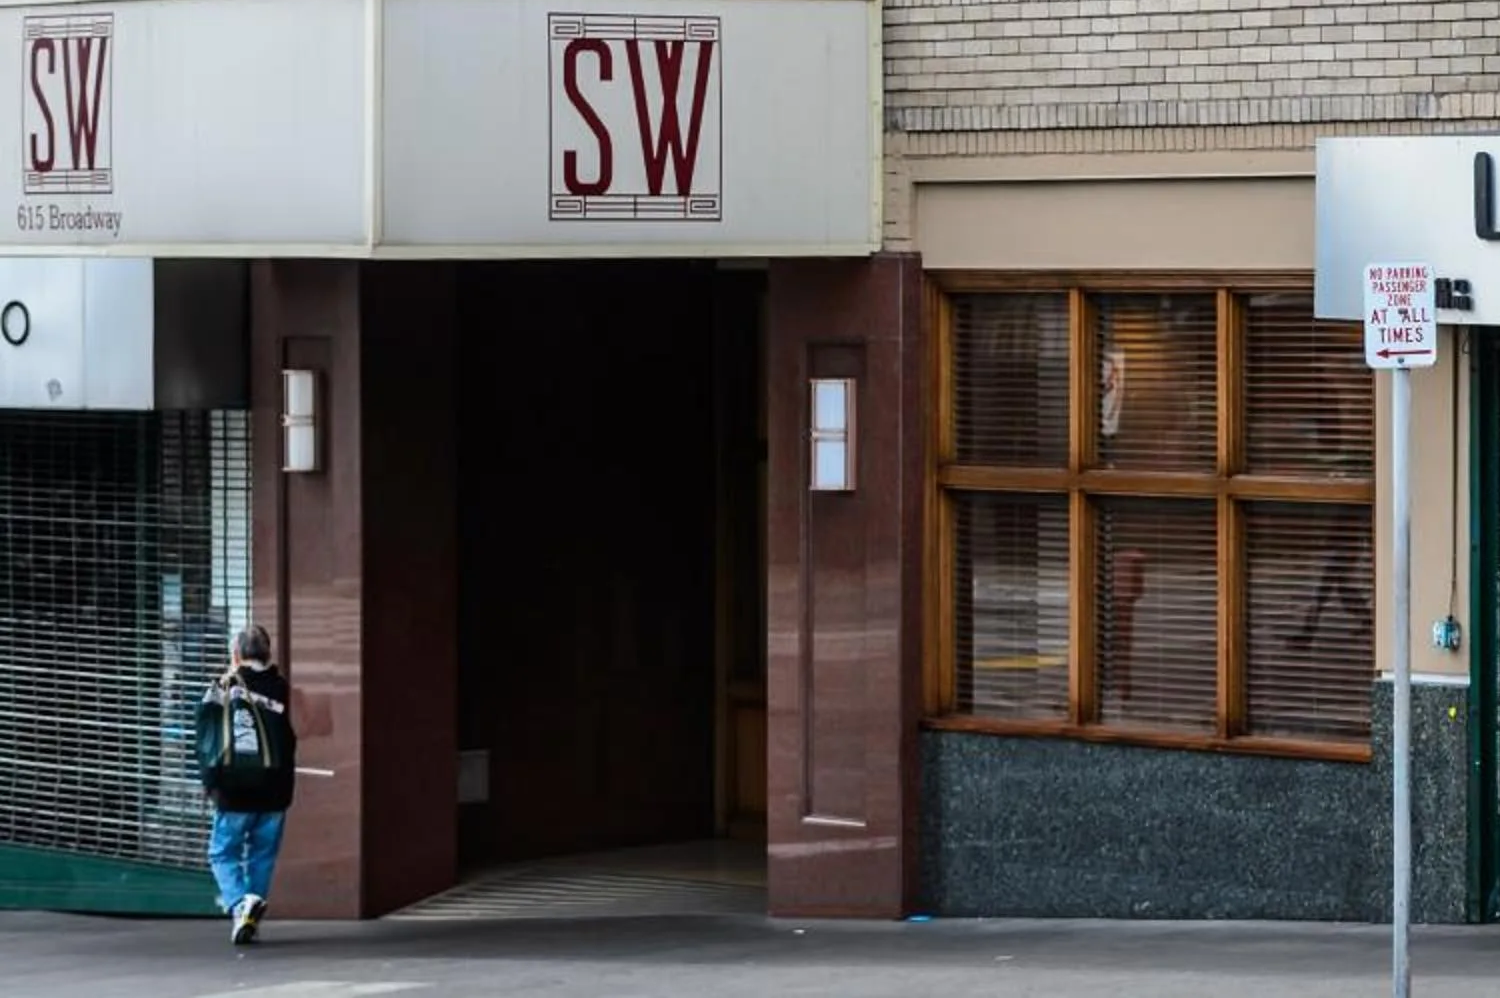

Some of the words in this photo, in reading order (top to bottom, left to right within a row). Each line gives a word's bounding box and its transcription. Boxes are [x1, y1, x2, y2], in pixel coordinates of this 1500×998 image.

[30, 37, 106, 172] SW
[562, 38, 714, 197] SW
[17, 205, 44, 231] 615
[49, 205, 123, 237] Broadway
[1370, 268, 1383, 280] NO
[1387, 267, 1428, 279] PARKING
[1372, 280, 1427, 293] PASSENGER
[1387, 294, 1412, 307] ZONE
[1371, 309, 1388, 324] AT
[1400, 308, 1431, 324] ALL
[1379, 327, 1424, 343] TIMES
